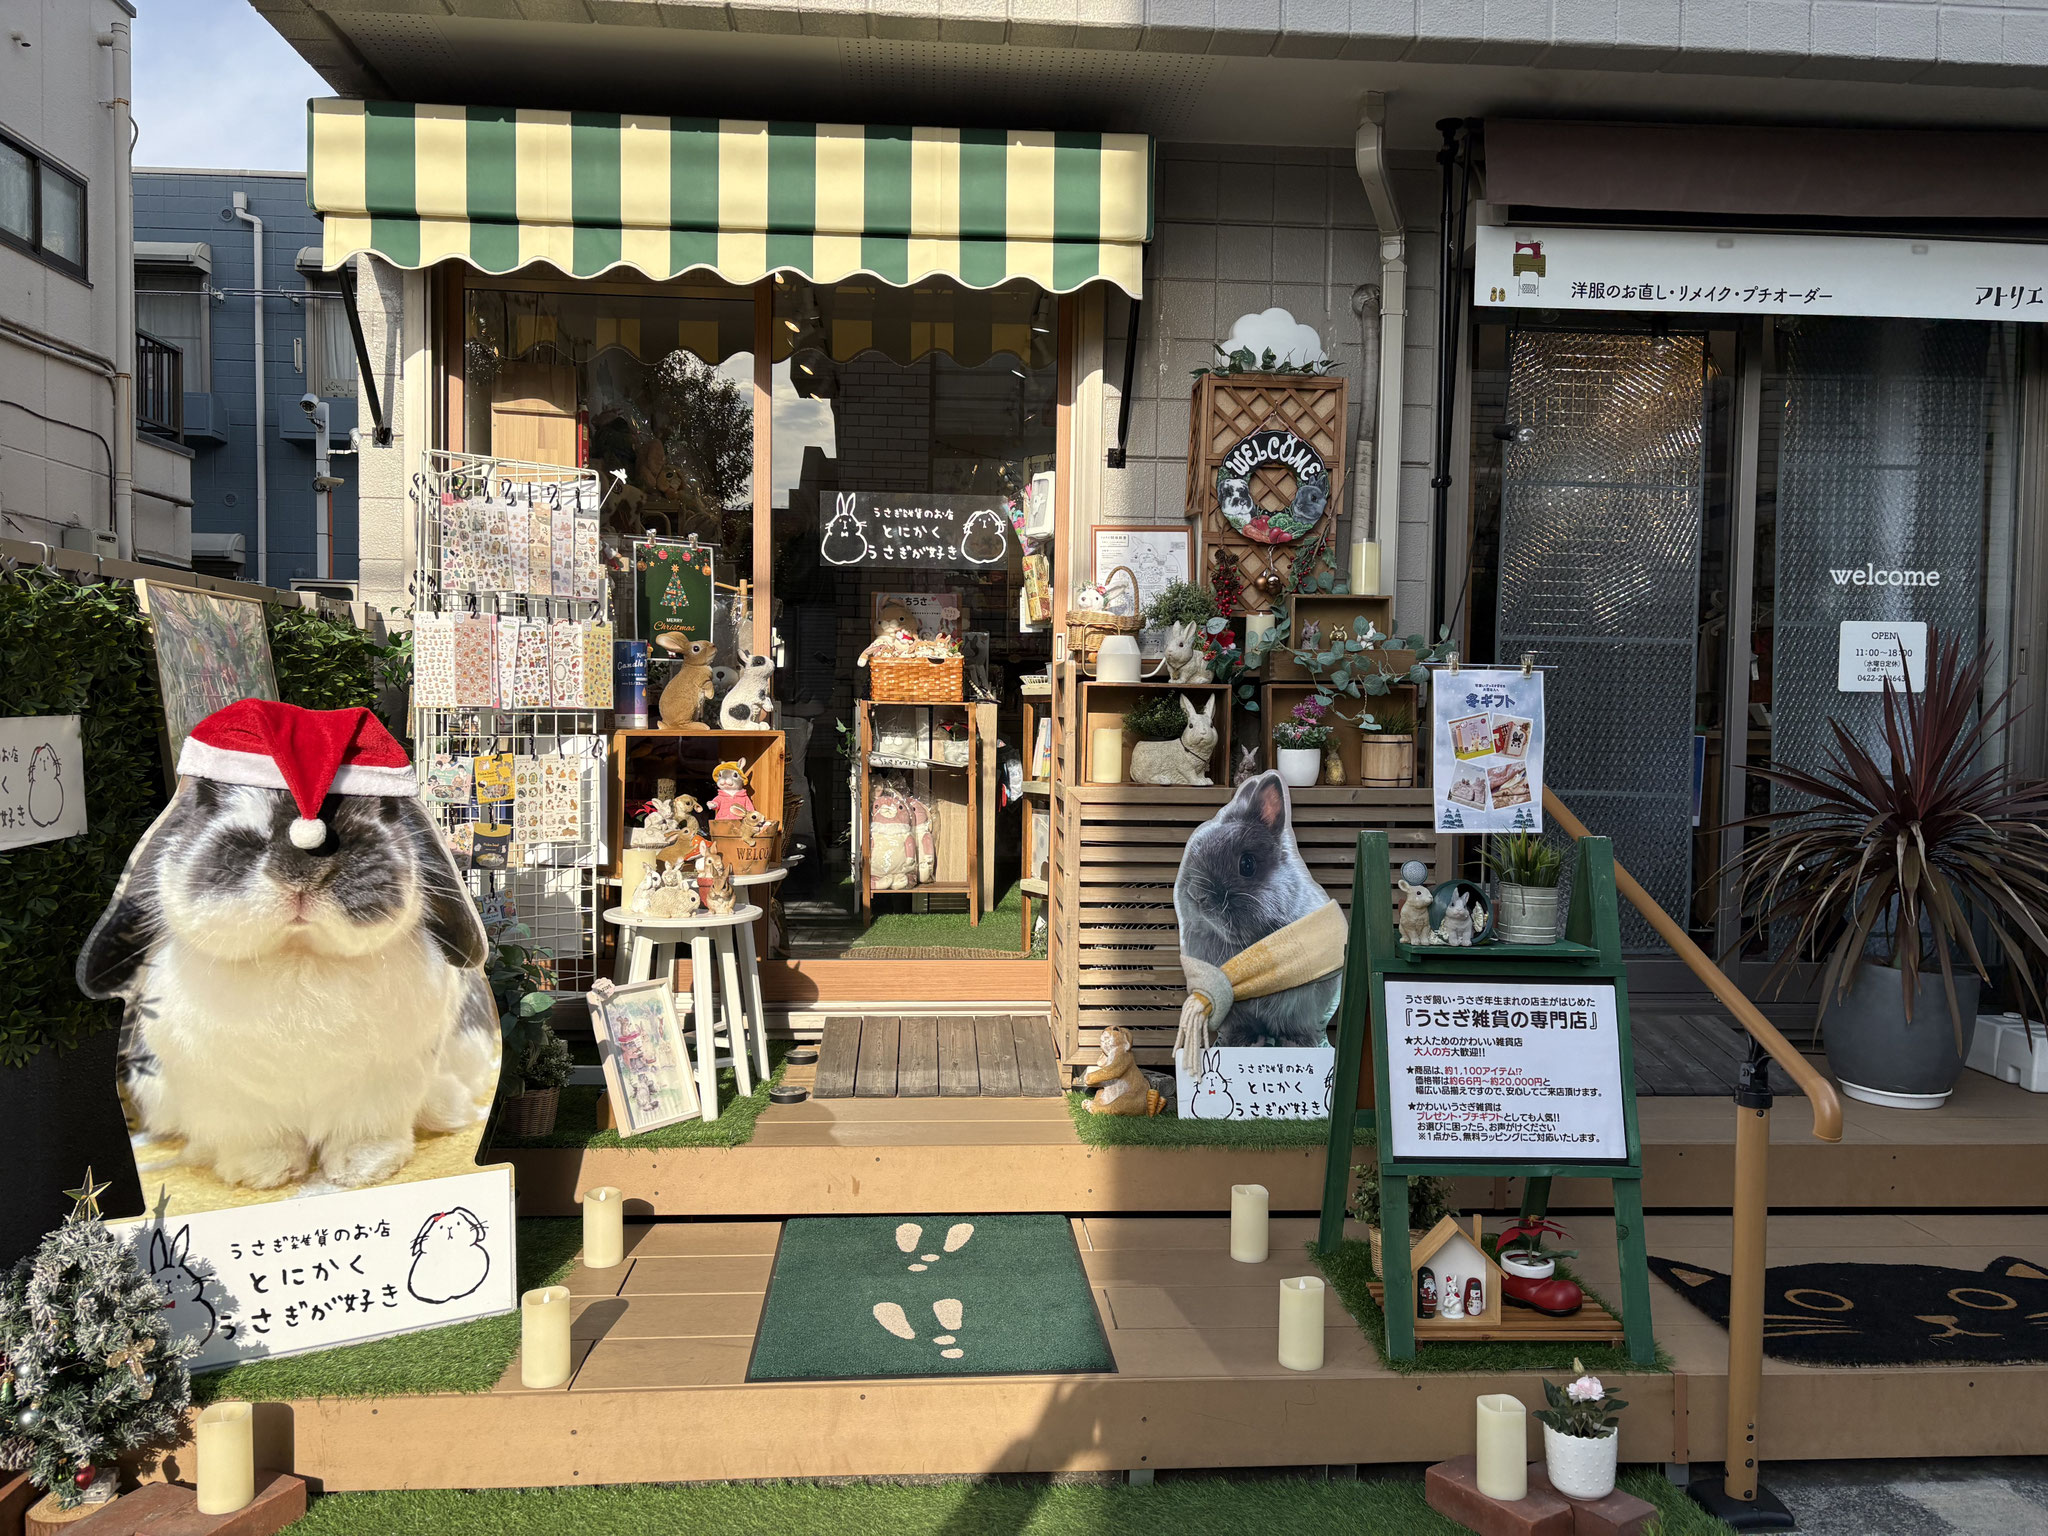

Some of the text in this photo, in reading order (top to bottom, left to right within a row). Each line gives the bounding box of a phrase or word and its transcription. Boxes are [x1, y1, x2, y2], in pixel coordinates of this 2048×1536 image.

[1571, 281, 2044, 310] 洋服のお直し・リメイク・プチオーダー アトリエ
[1225, 434, 1321, 481] WELCOME
[873, 507, 954, 520] うさぎ雑貨のお店
[882, 524, 940, 539] とにかく
[868, 544, 957, 560] うさぎが好き
[1829, 562, 1941, 587] welcome
[653, 620, 696, 631] Christmas
[1871, 631, 1897, 640] OPEN
[1465, 692, 1516, 708] 冬ギフト
[1404, 1007, 1598, 1030] 『うさぎ雑貨の専門店』
[1237, 1063, 1314, 1075] うさぎ雑貨のお店
[1247, 1080, 1303, 1095] とにかく
[1235, 1100, 1321, 1117] うさぎが好き
[230, 1218, 391, 1260] うさぎ雑貨のお店
[249, 1253, 366, 1293] とにかく
[219, 1282, 399, 1341] うさぎが好き
